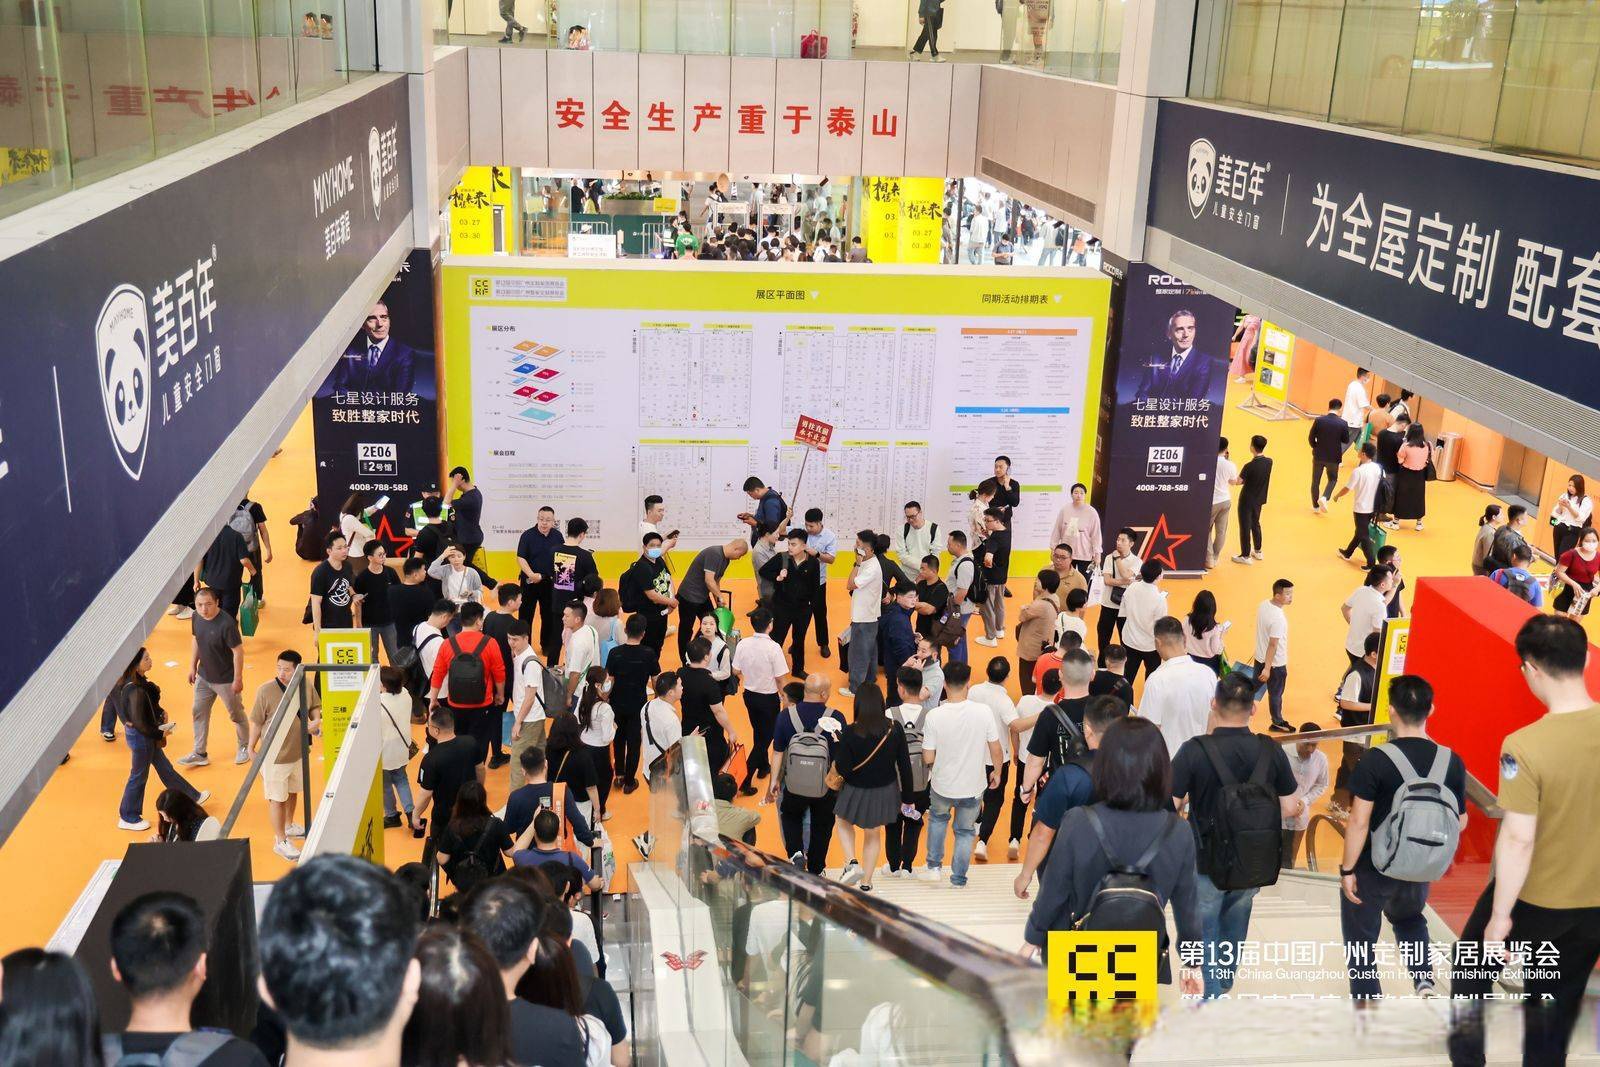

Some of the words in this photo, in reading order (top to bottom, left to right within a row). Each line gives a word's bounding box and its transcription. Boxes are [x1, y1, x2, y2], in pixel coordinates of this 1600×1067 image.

[555, 98, 899, 139] 安全生产重于泰山
[1215, 154, 1266, 205] 美百年
[313, 155, 354, 218] MAYHOME
[1212, 201, 1260, 230] 儿童安全门窗
[1305, 182, 1501, 310] 为全屋定制
[1148, 274, 1193, 286] ROC
[755, 289, 806, 300] 展区平面图
[981, 293, 1049, 304] 同期活动排期表
[153, 259, 217, 378] 美百年
[161, 345, 221, 426] 儿童安全门窗
[331, 391, 419, 406] 七星设计服务
[1132, 398, 1211, 411] 七星设计服务
[332, 409, 420, 424] 致胜整家时代
[1131, 415, 1209, 428] 致胜整家时代
[362, 446, 391, 458] 2E06
[1153, 449, 1178, 460] 2E06
[368, 461, 393, 472] 2号馆
[1156, 463, 1177, 473] 2号馆
[349, 483, 409, 491] 4008-788-588
[1136, 484, 1189, 492] 4008-788-588
